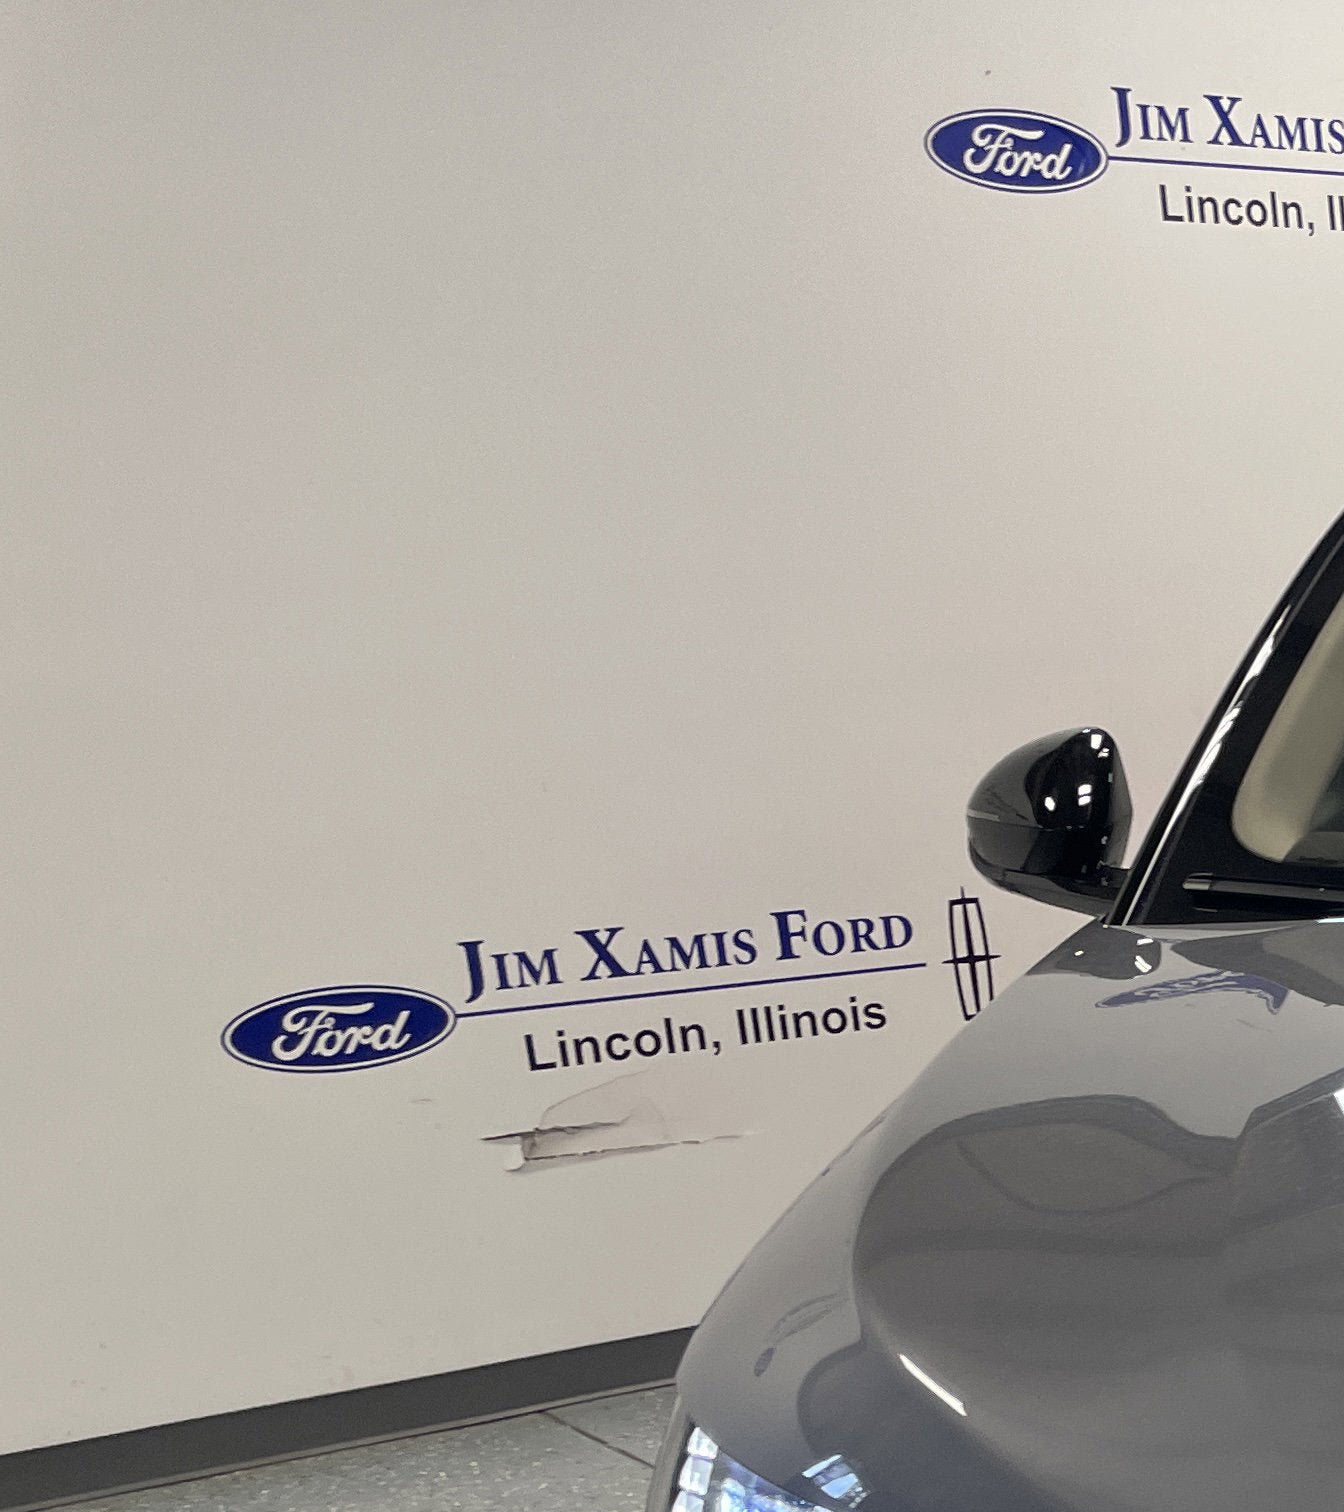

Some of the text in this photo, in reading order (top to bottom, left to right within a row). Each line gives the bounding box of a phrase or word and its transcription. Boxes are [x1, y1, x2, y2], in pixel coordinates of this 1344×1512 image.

[961, 123, 1073, 182] Ford
[1158, 183, 1316, 237] Lincoln,
[270, 1003, 412, 1062] Ford
[523, 997, 889, 1073] Lincoln, Illinois
